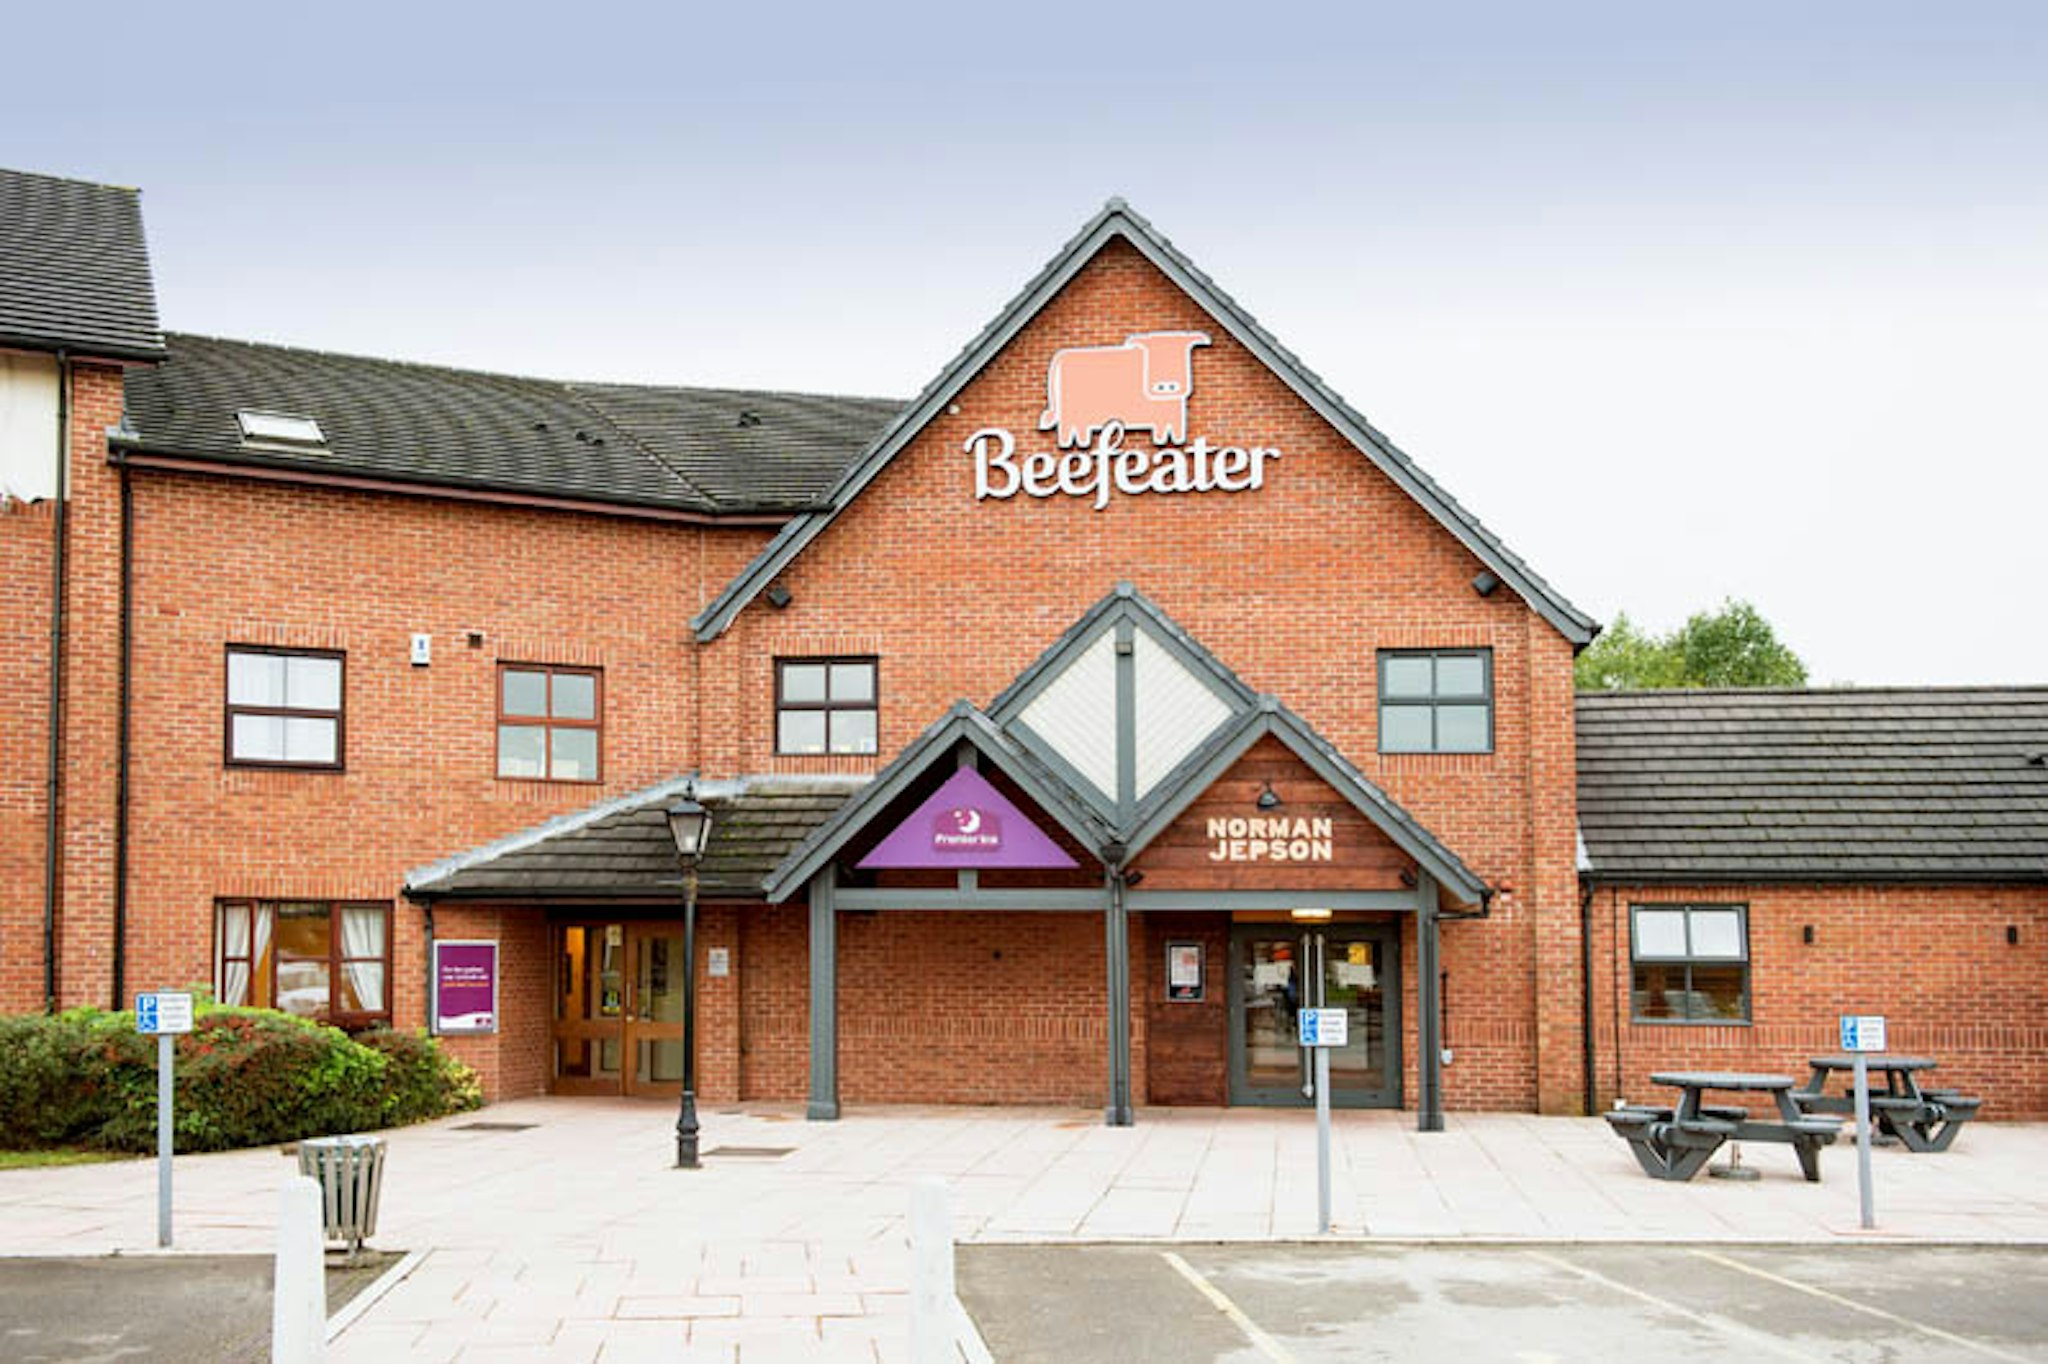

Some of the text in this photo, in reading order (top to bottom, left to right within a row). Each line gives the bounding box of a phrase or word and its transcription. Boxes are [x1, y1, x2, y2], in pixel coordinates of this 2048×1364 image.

[964, 419, 1281, 510] Beefeater
[1207, 818, 1332, 838] NORMAN
[1208, 839, 1332, 861] JEPSON
[143, 997, 155, 1011] P
